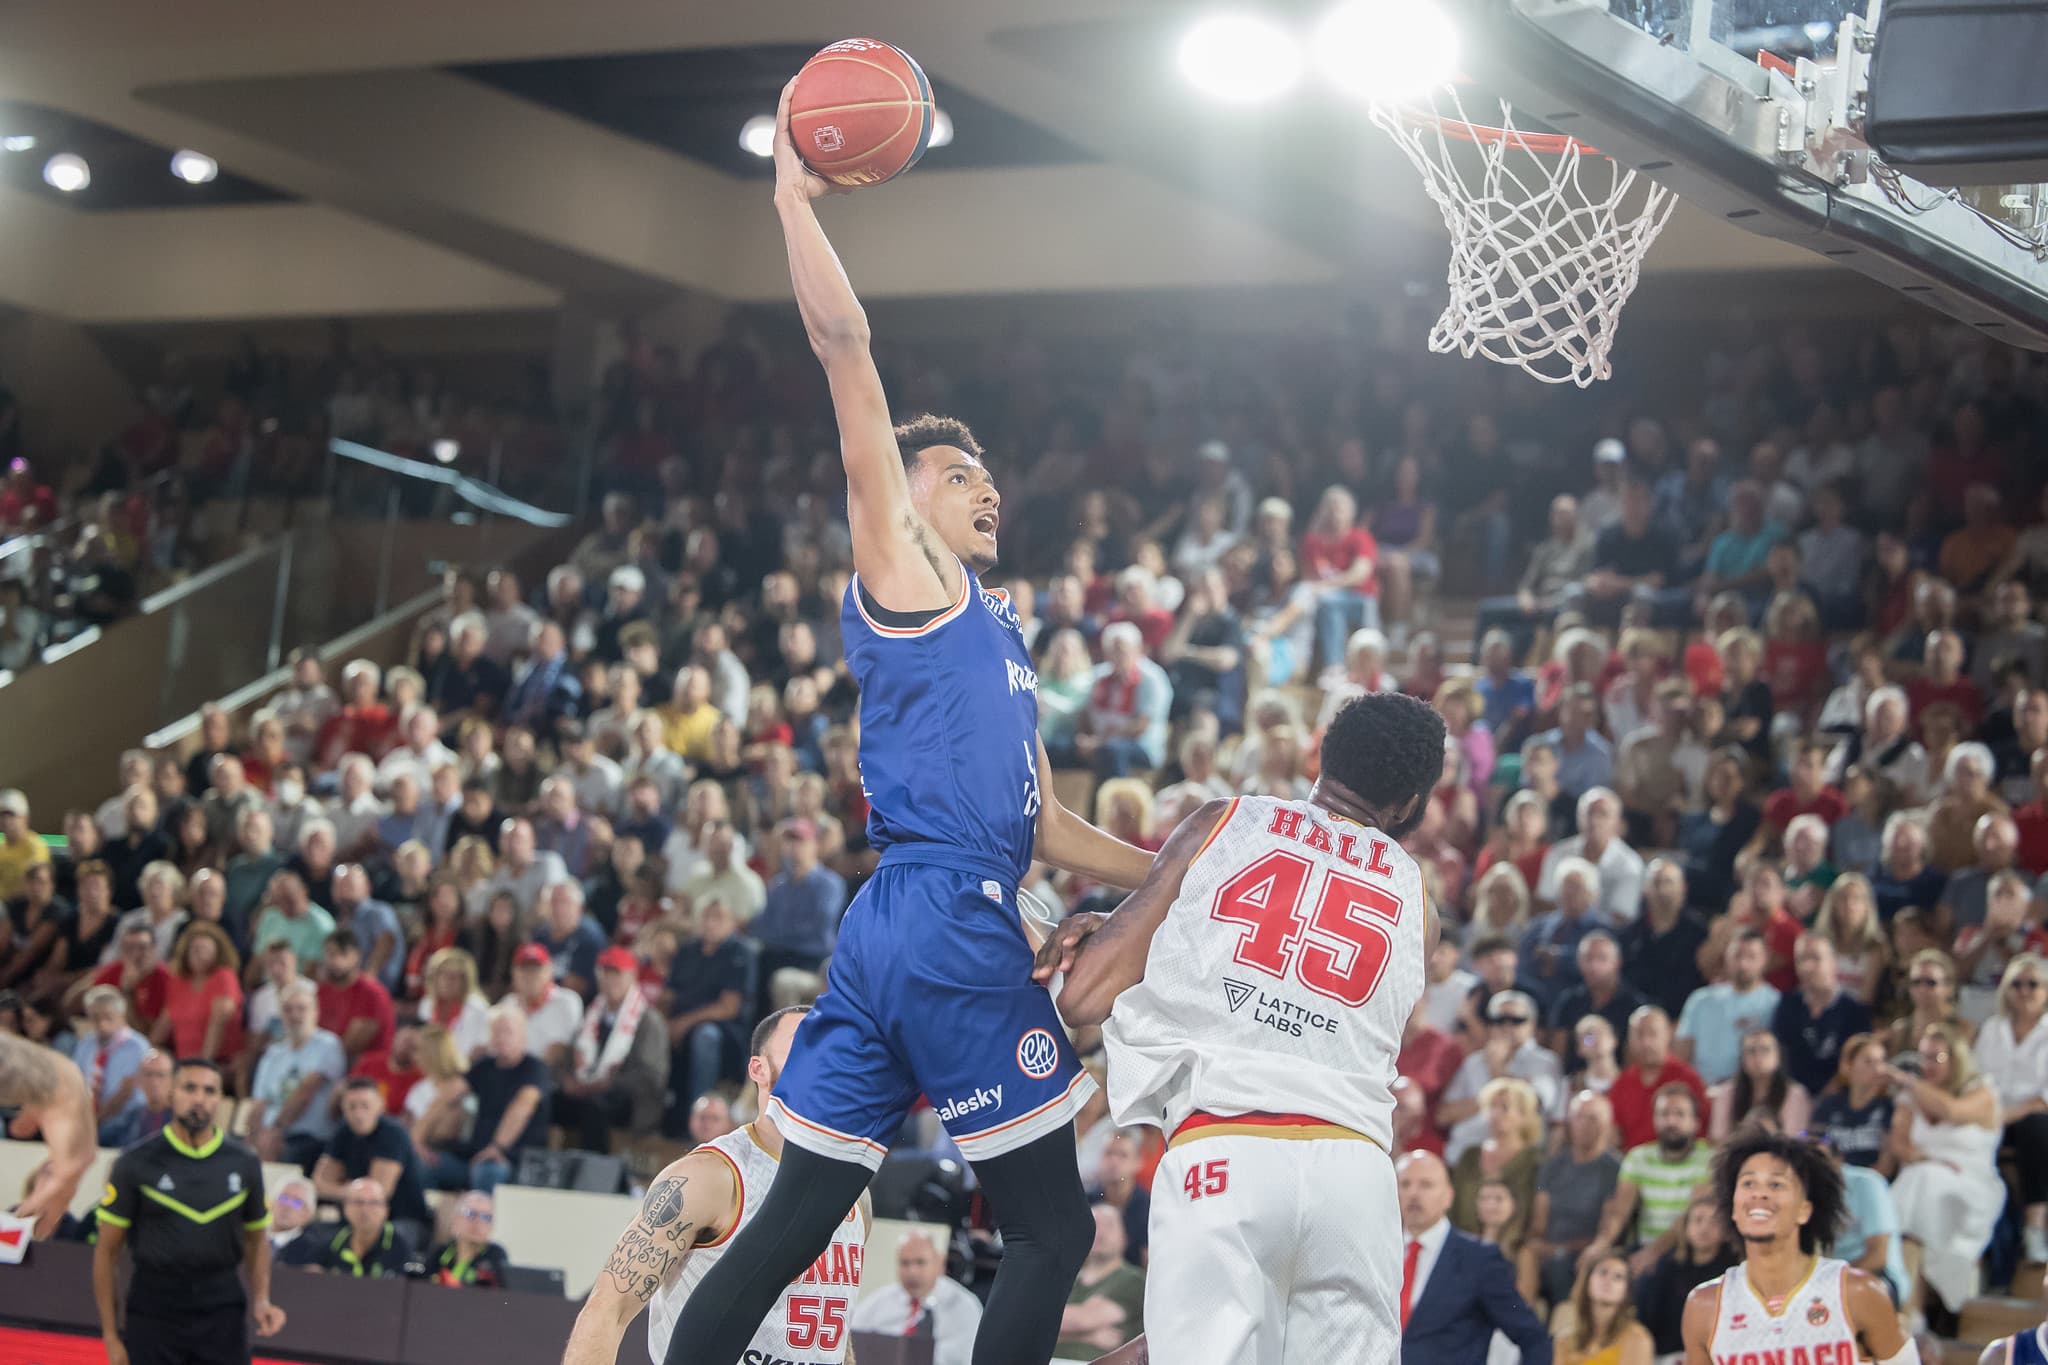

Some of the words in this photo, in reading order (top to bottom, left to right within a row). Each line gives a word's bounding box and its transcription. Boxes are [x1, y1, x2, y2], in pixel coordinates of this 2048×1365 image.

[1267, 806, 1394, 879] HALL
[1210, 848, 1403, 1009] 45
[1254, 1008, 1302, 1038] LABS
[1258, 992, 1339, 1034] LATTICE
[1184, 1159, 1230, 1202] 45
[790, 1242, 864, 1287] NAC
[786, 1295, 848, 1351] 55
